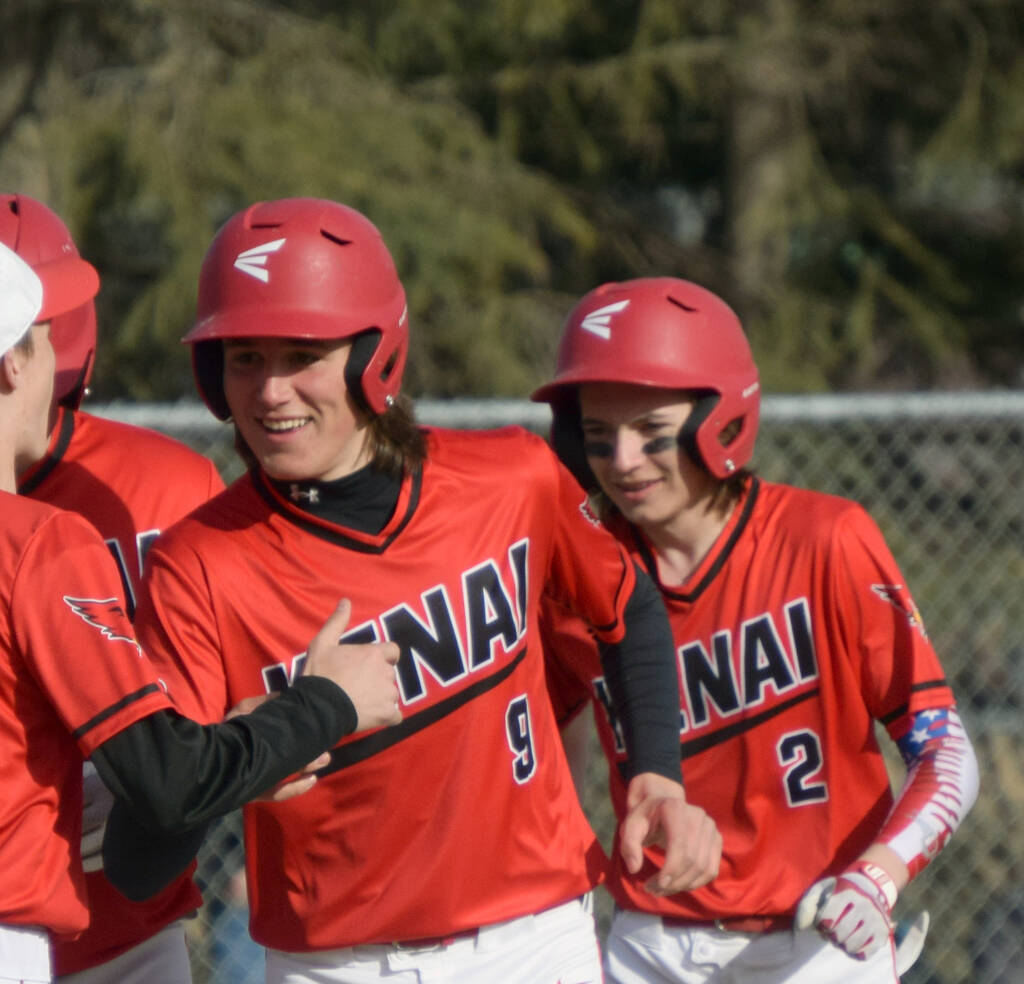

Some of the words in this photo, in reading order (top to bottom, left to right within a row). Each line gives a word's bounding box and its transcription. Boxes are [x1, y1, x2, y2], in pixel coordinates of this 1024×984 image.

[262, 537, 530, 706] NAI
[591, 596, 820, 754] NAI
[504, 693, 538, 785] 9
[775, 727, 830, 808] 2
